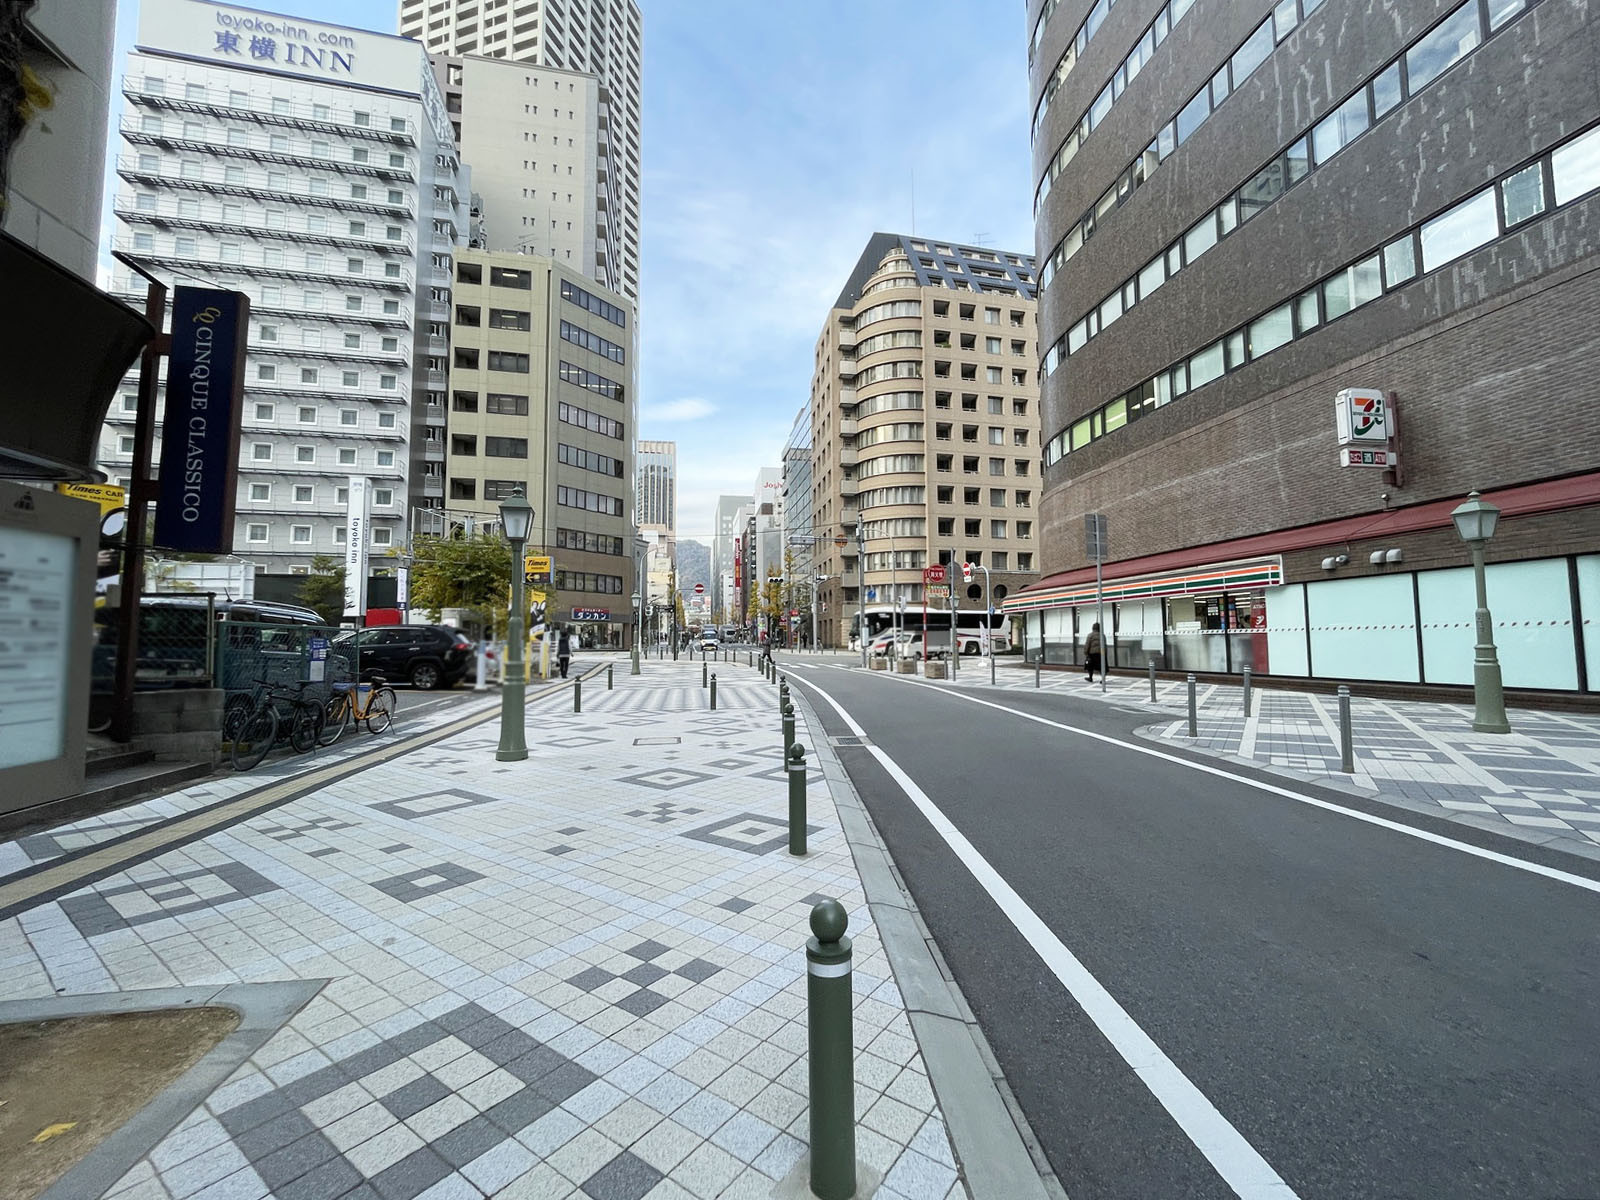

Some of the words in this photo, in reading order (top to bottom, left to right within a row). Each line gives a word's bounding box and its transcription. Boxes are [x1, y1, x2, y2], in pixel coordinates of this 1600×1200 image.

[190, 327, 214, 410] CINQUE
[182, 416, 207, 522] CLASSICO
[67, 484, 102, 495] Times
[351, 517, 360, 548] toyoko
[351, 550, 359, 564] inn
